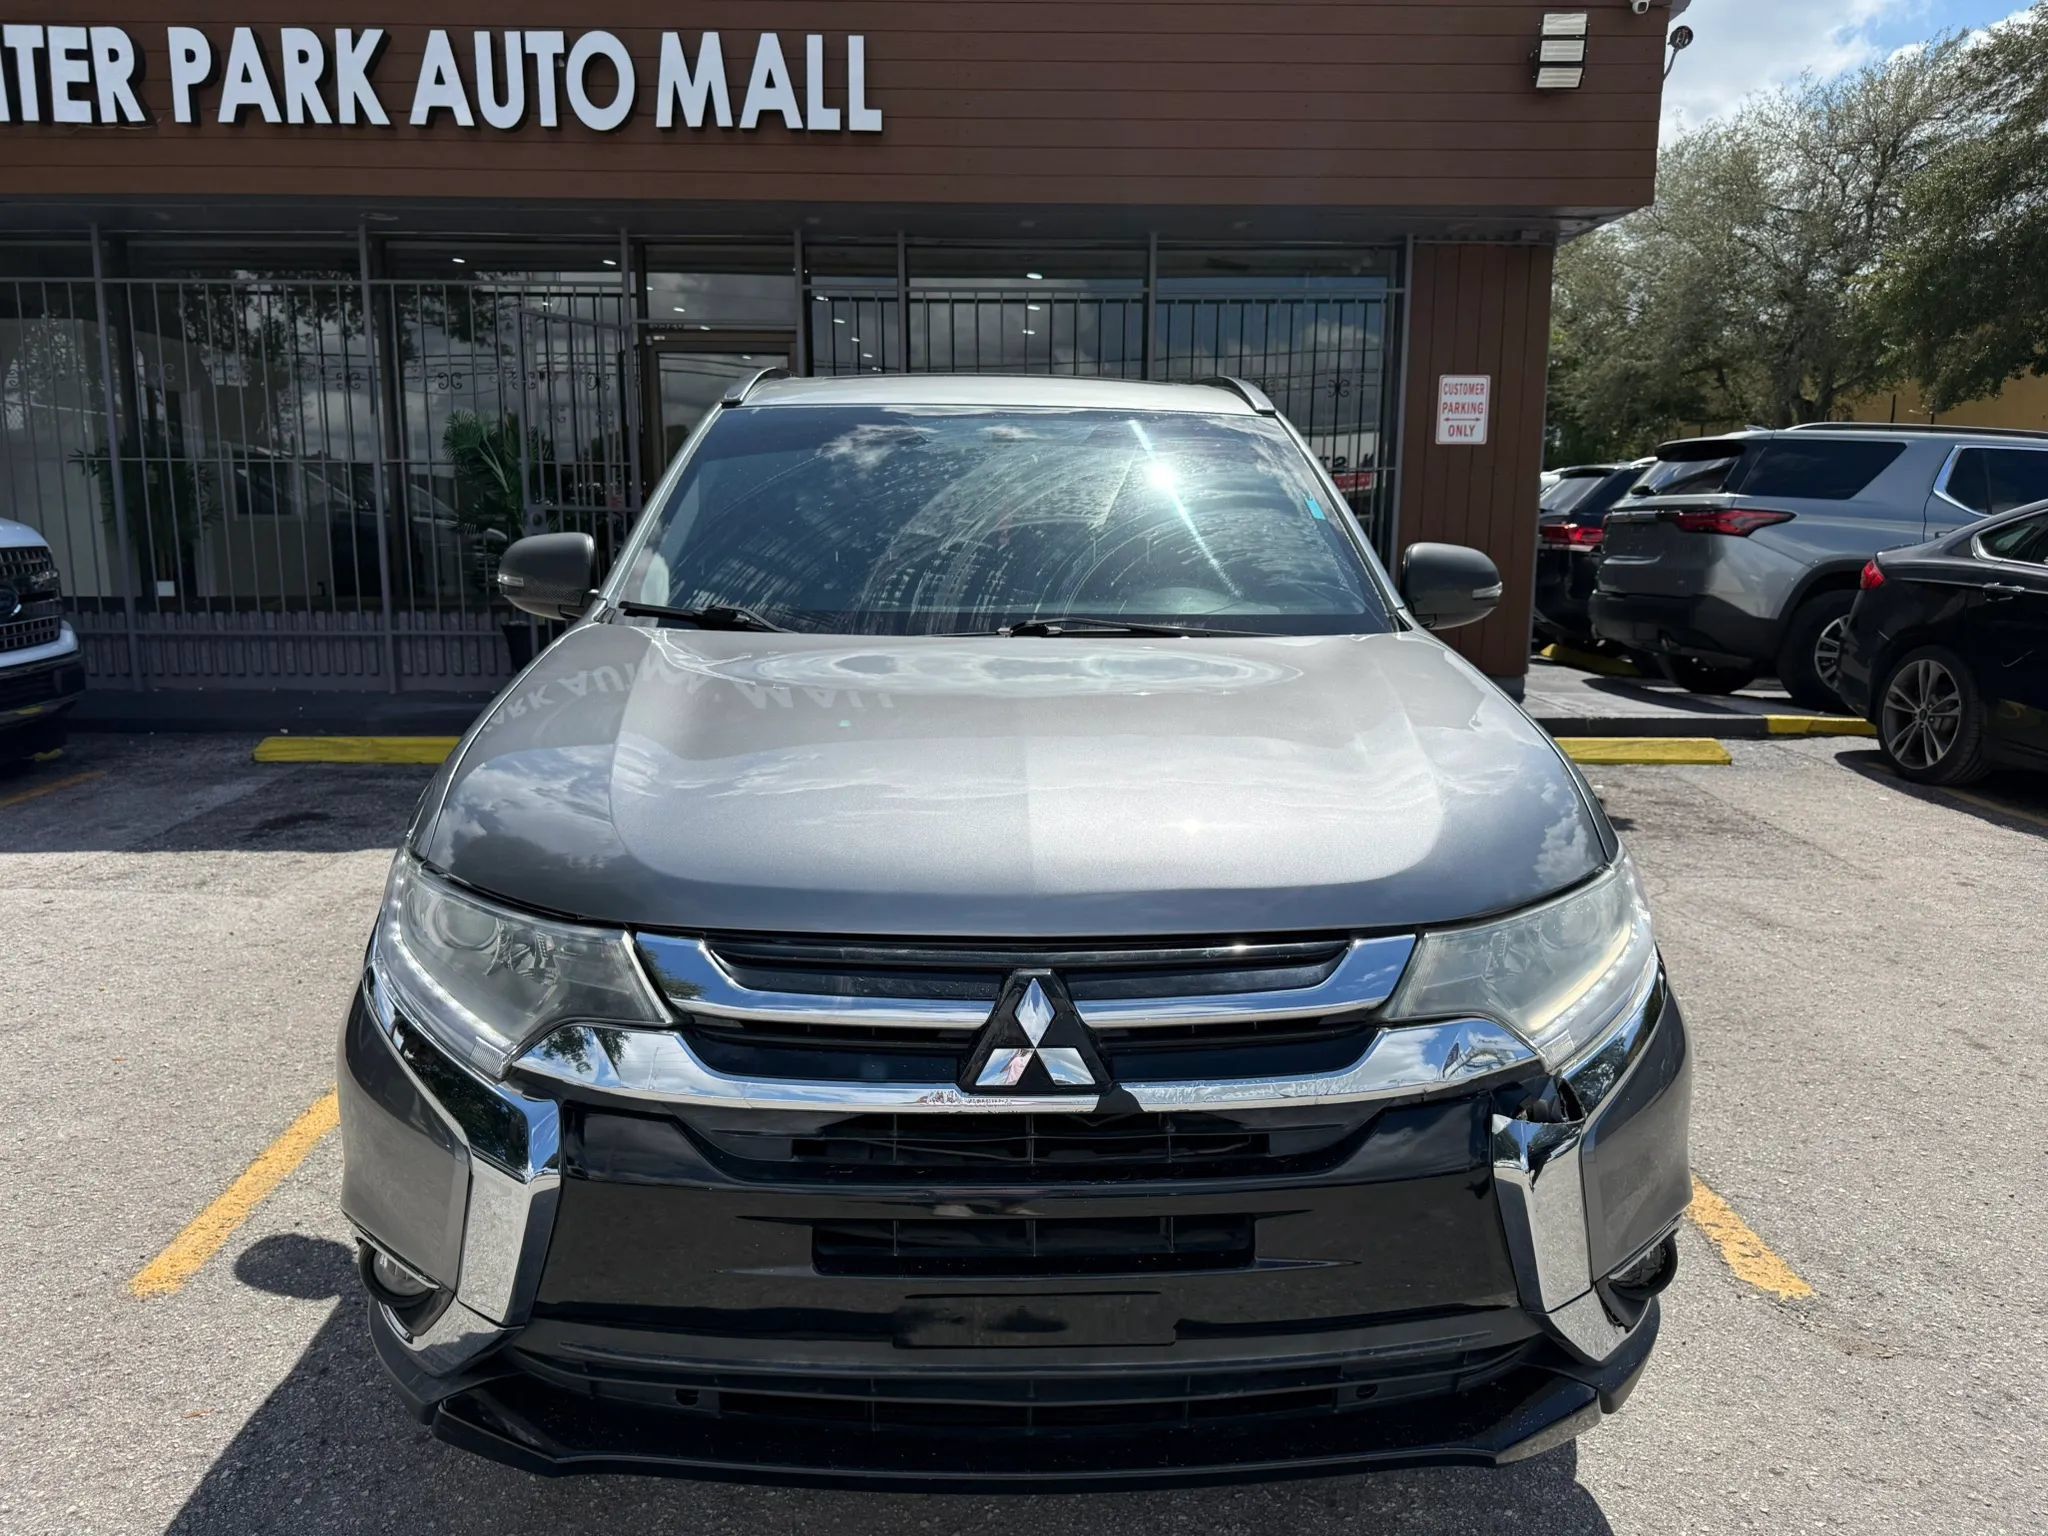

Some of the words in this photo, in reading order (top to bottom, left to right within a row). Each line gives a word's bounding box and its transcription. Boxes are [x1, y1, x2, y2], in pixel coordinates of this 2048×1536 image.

[0, 25, 146, 123] TER
[167, 27, 390, 125] PARK
[409, 30, 635, 131] AUTO
[656, 32, 882, 131] MALL
[1443, 383, 1485, 395] CUSTOMER
[1442, 402, 1484, 414] PARKING
[1447, 424, 1476, 437] ONLY
